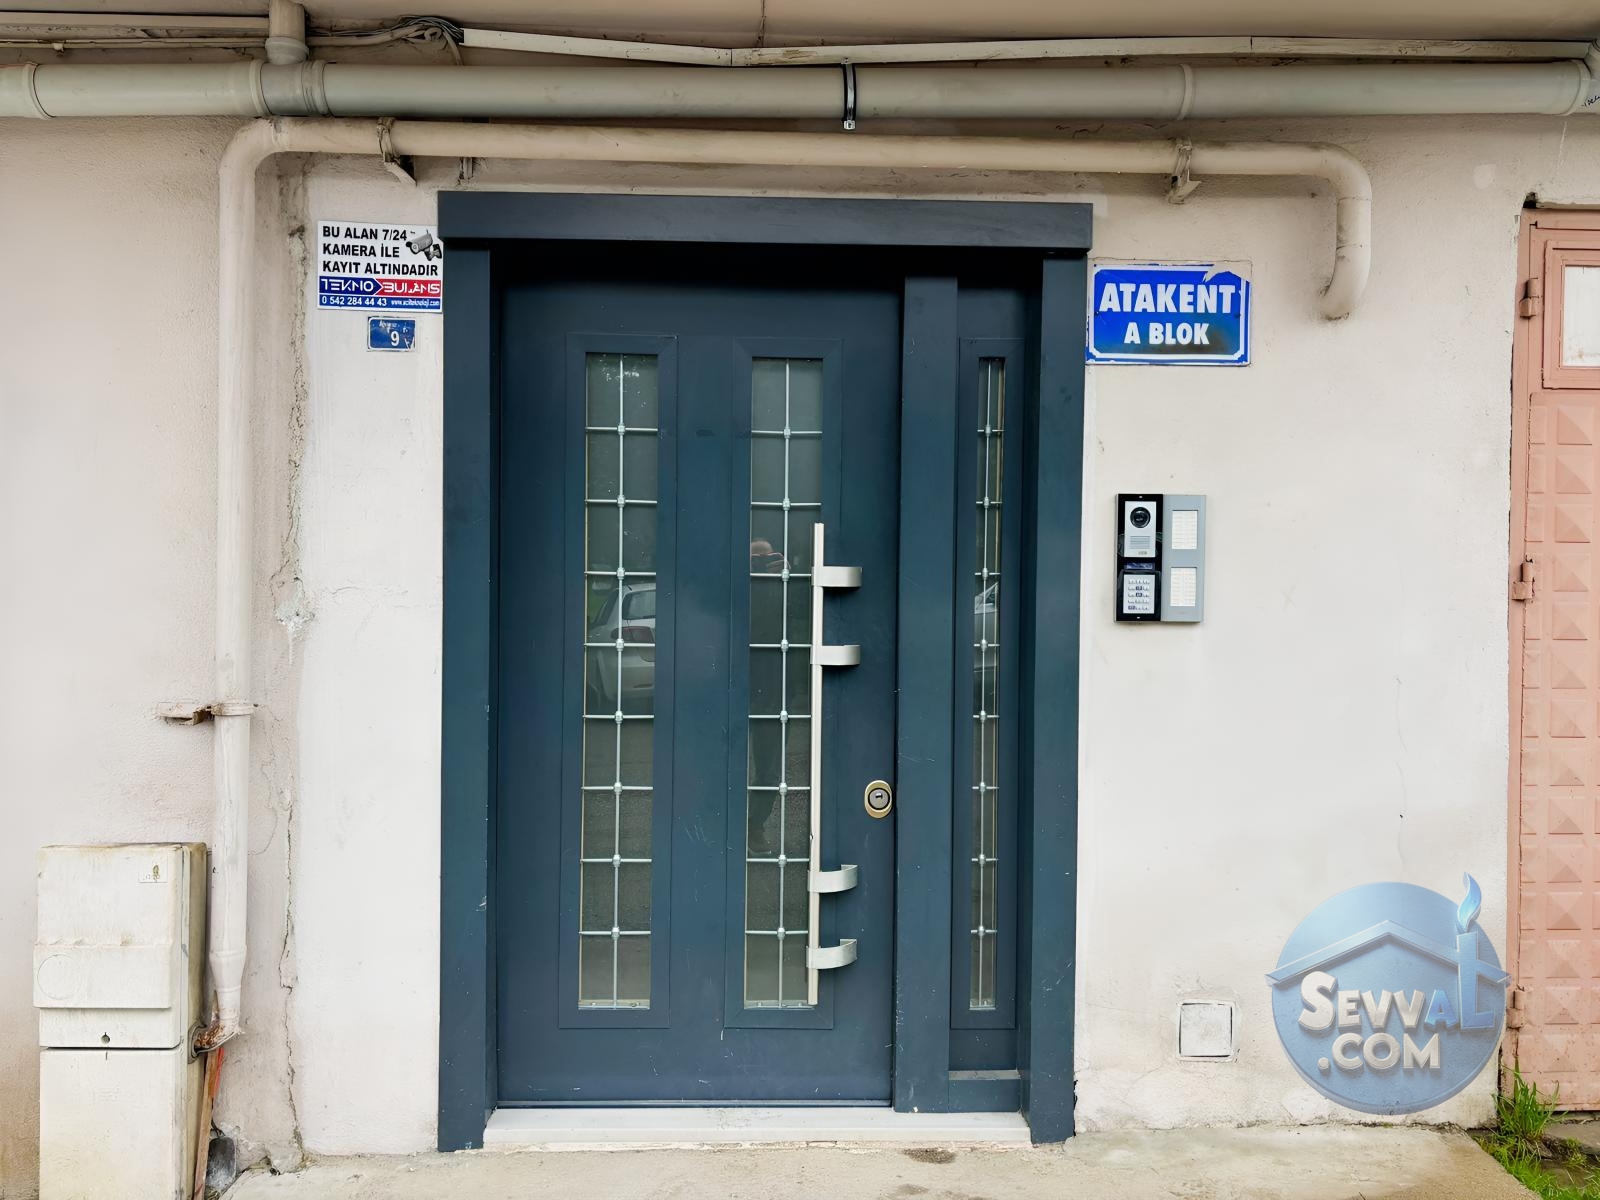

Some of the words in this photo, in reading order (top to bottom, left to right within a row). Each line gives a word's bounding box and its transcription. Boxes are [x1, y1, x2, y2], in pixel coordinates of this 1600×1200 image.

[322, 225, 340, 238] BU
[344, 227, 378, 240] ALAN
[382, 229, 407, 241] 7/24
[322, 243, 377, 257] KAMERA
[380, 243, 400, 258] İLE
[322, 260, 361, 274] KAYIT
[364, 262, 438, 276] ALTINDADIR
[321, 296, 327, 305] 0
[330, 296, 345, 306] 542
[347, 297, 362, 306] 284
[364, 298, 375, 306] 44
[376, 298, 387, 306] 43
[1099, 283, 1236, 314] ATAKENT
[390, 331, 400, 347] 9
[1123, 321, 1141, 344] A
[1148, 322, 1210, 345] BLOK
